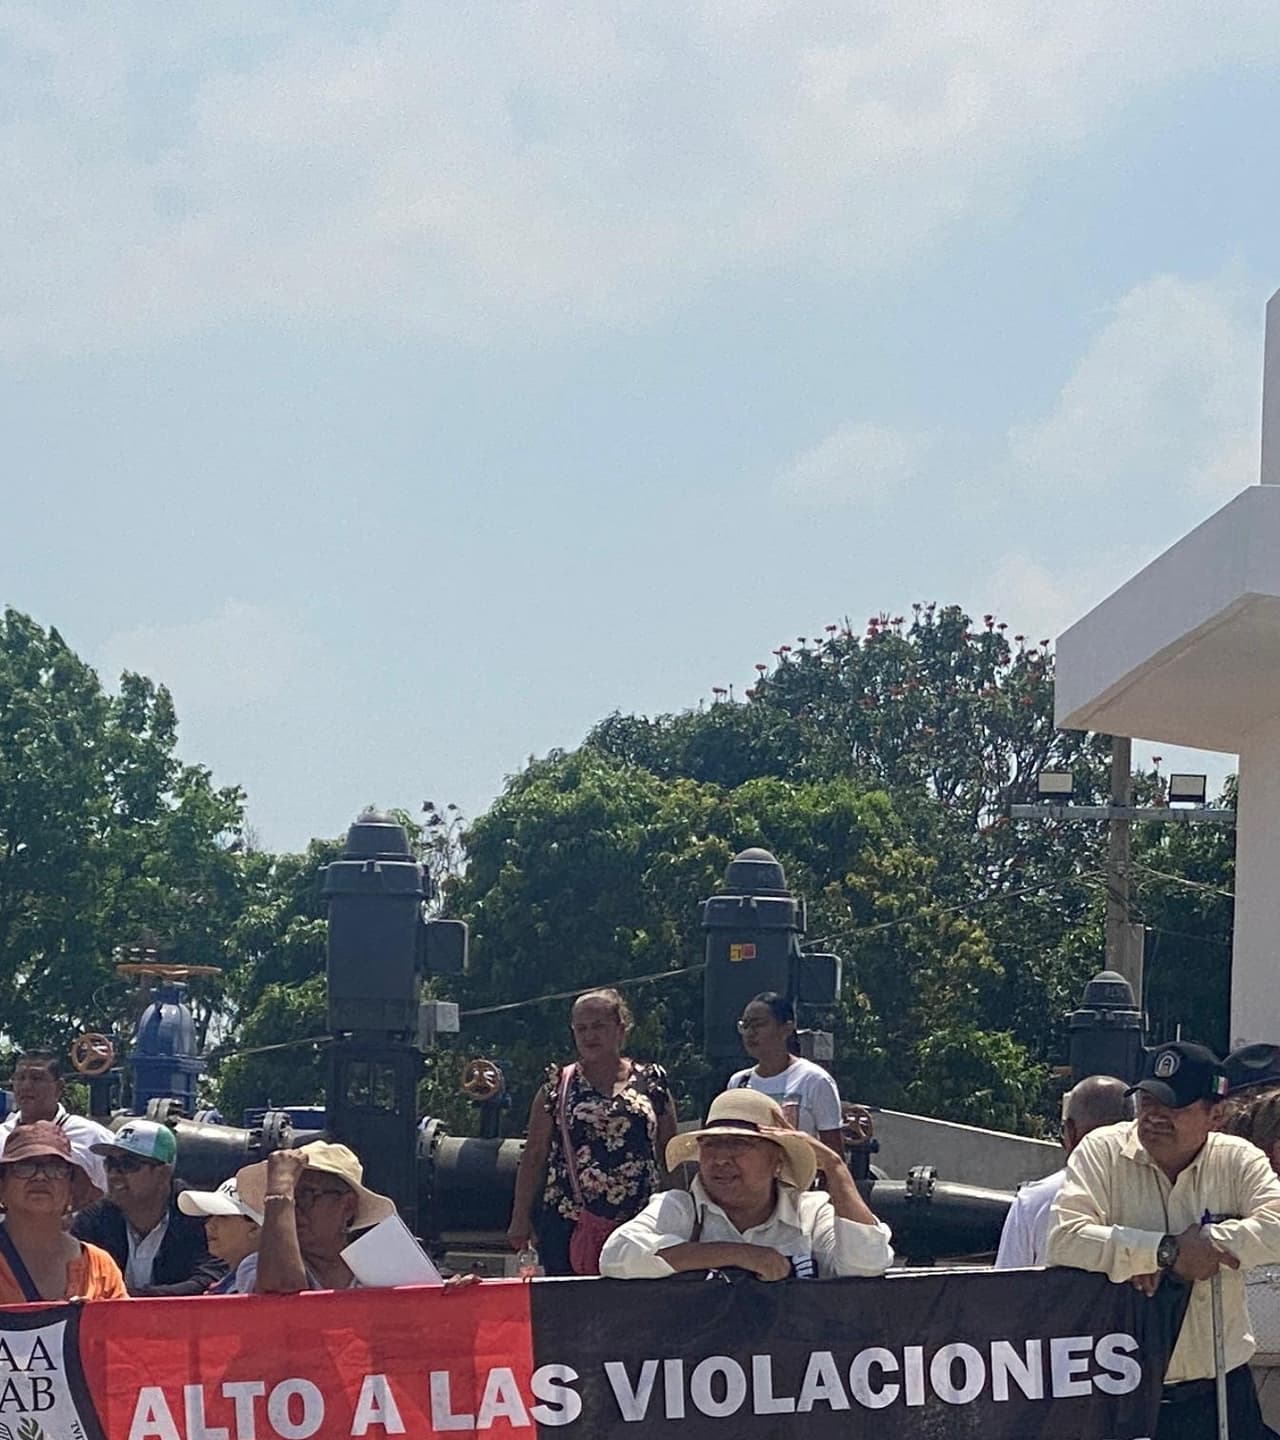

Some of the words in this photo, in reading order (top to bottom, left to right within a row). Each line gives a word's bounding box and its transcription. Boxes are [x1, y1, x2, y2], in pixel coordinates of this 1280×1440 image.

[352, 1374, 406, 1437] A
[428, 1364, 583, 1433] LAS
[605, 1332, 1142, 1422] VIOLACIONES
